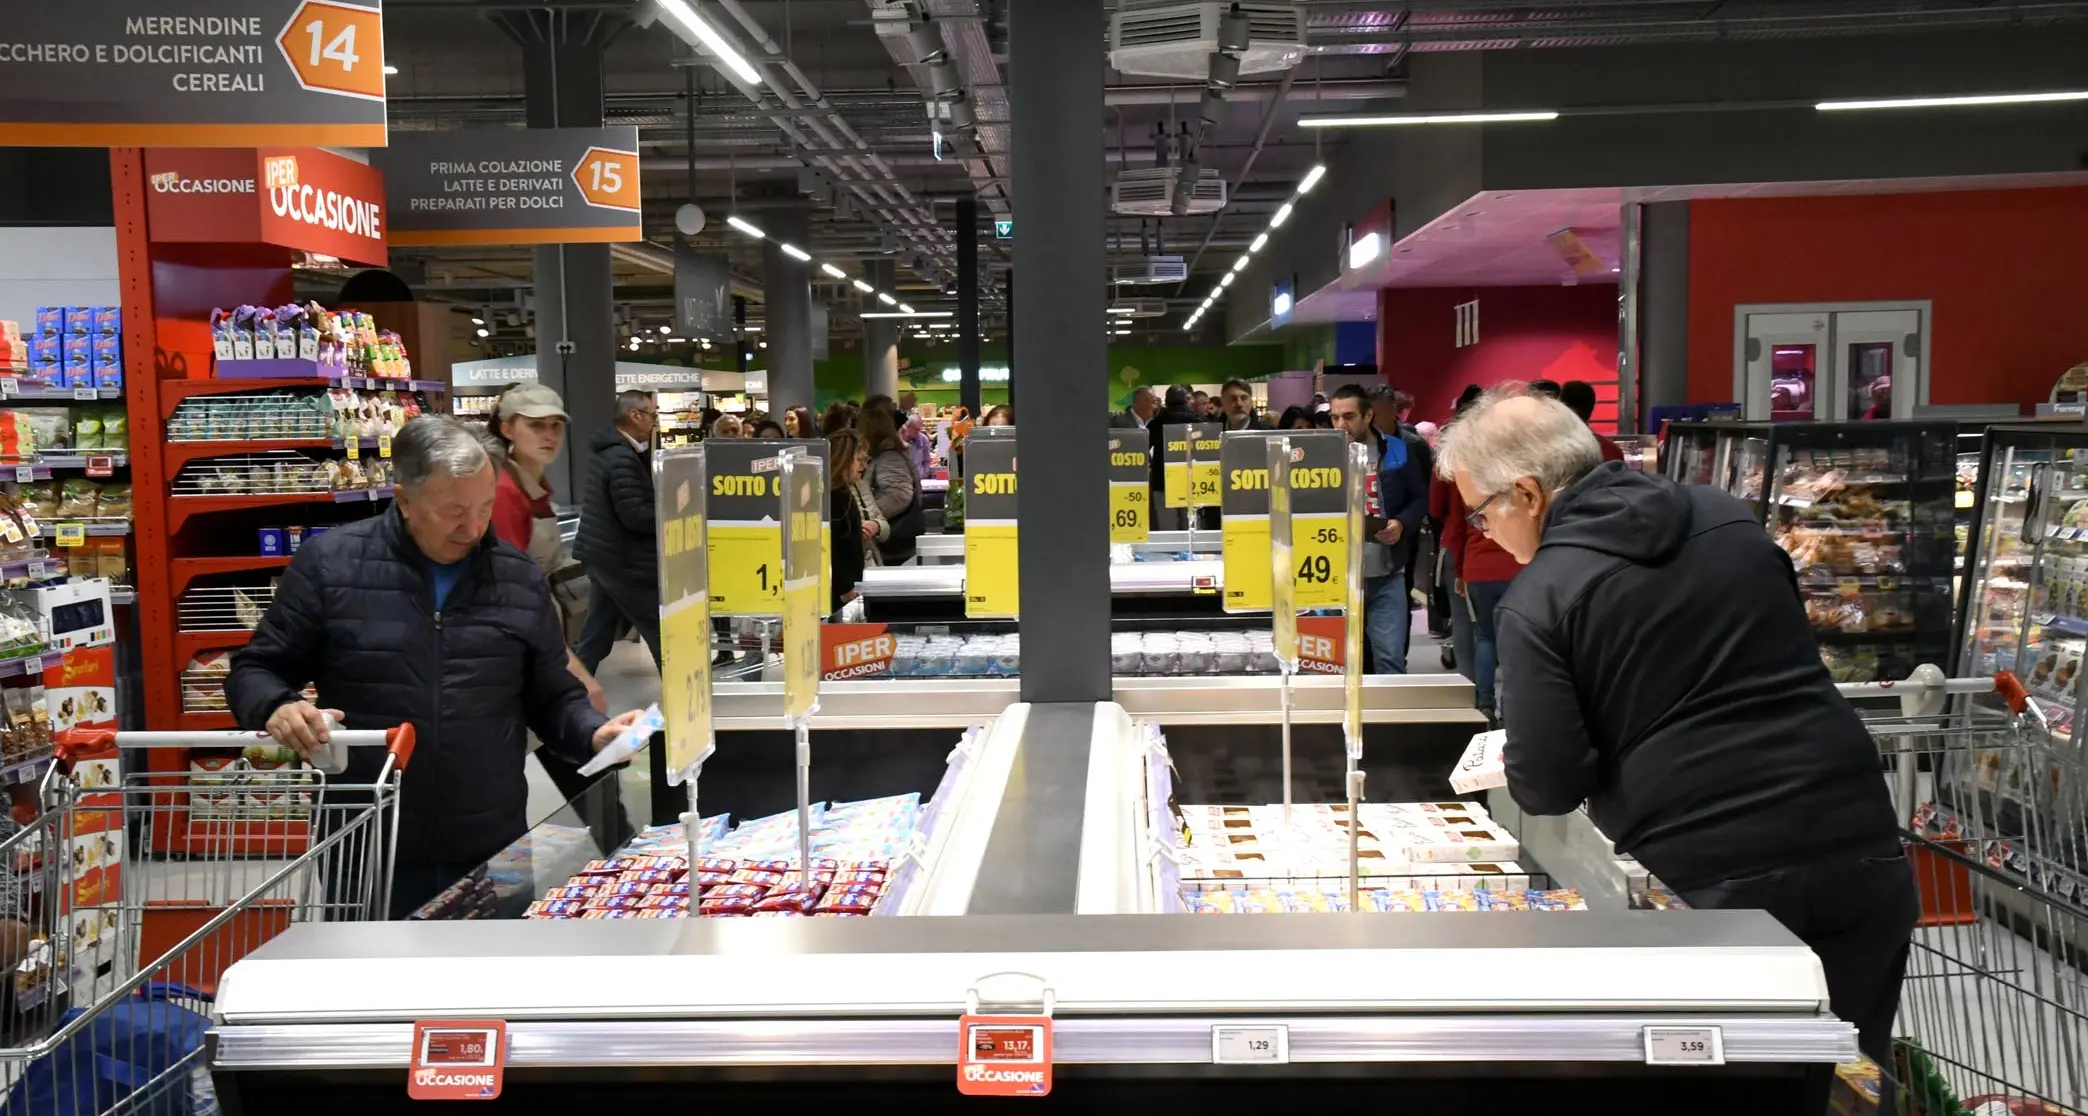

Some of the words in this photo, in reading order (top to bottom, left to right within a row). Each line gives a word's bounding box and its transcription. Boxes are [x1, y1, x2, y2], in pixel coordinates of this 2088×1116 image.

[126, 17, 262, 36] MERENDINE
[304, 20, 361, 72] 14
[96, 45, 107, 63] E
[113, 45, 263, 65] DOLCIFICANTI
[173, 73, 265, 92] CEREALI
[266, 159, 297, 187] IPER
[430, 162, 476, 174] PRIMA
[479, 160, 562, 173] COLAZIONE
[444, 179, 485, 192] LATTE
[487, 179, 496, 191] E
[500, 178, 563, 192] DERIVATI
[590, 160, 623, 193] 15
[154, 179, 256, 194] OCCASIONE
[270, 184, 382, 240] OCCASIONE
[411, 197, 485, 211] PREPARATI
[490, 197, 517, 210] PER
[520, 196, 565, 209] DOLCI
[470, 369, 501, 380] LATTE
[638, 373, 699, 384] ENERGETICHE
[1167, 441, 1189, 452] SOTT
[1195, 440, 1221, 451] COSTO
[1110, 452, 1145, 467] COSTO
[712, 475, 766, 496] SOTTO
[973, 473, 1017, 495] SOTT
[1230, 469, 1269, 490] SOTT
[1290, 467, 1342, 489] COSTO
[1111, 509, 1138, 531] ,69
[1293, 555, 1331, 587] ,49
[837, 637, 891, 666] IPER
[824, 660, 887, 681] OCCASIONI
[459, 1043, 482, 1055] 1,80
[1003, 1040, 1028, 1052] 13,17
[1248, 1040, 1269, 1051] 1,29
[1680, 1041, 1705, 1053] 3,59
[416, 1074, 495, 1087] OCCASIONE
[964, 1070, 1045, 1083] OCCASIONE
